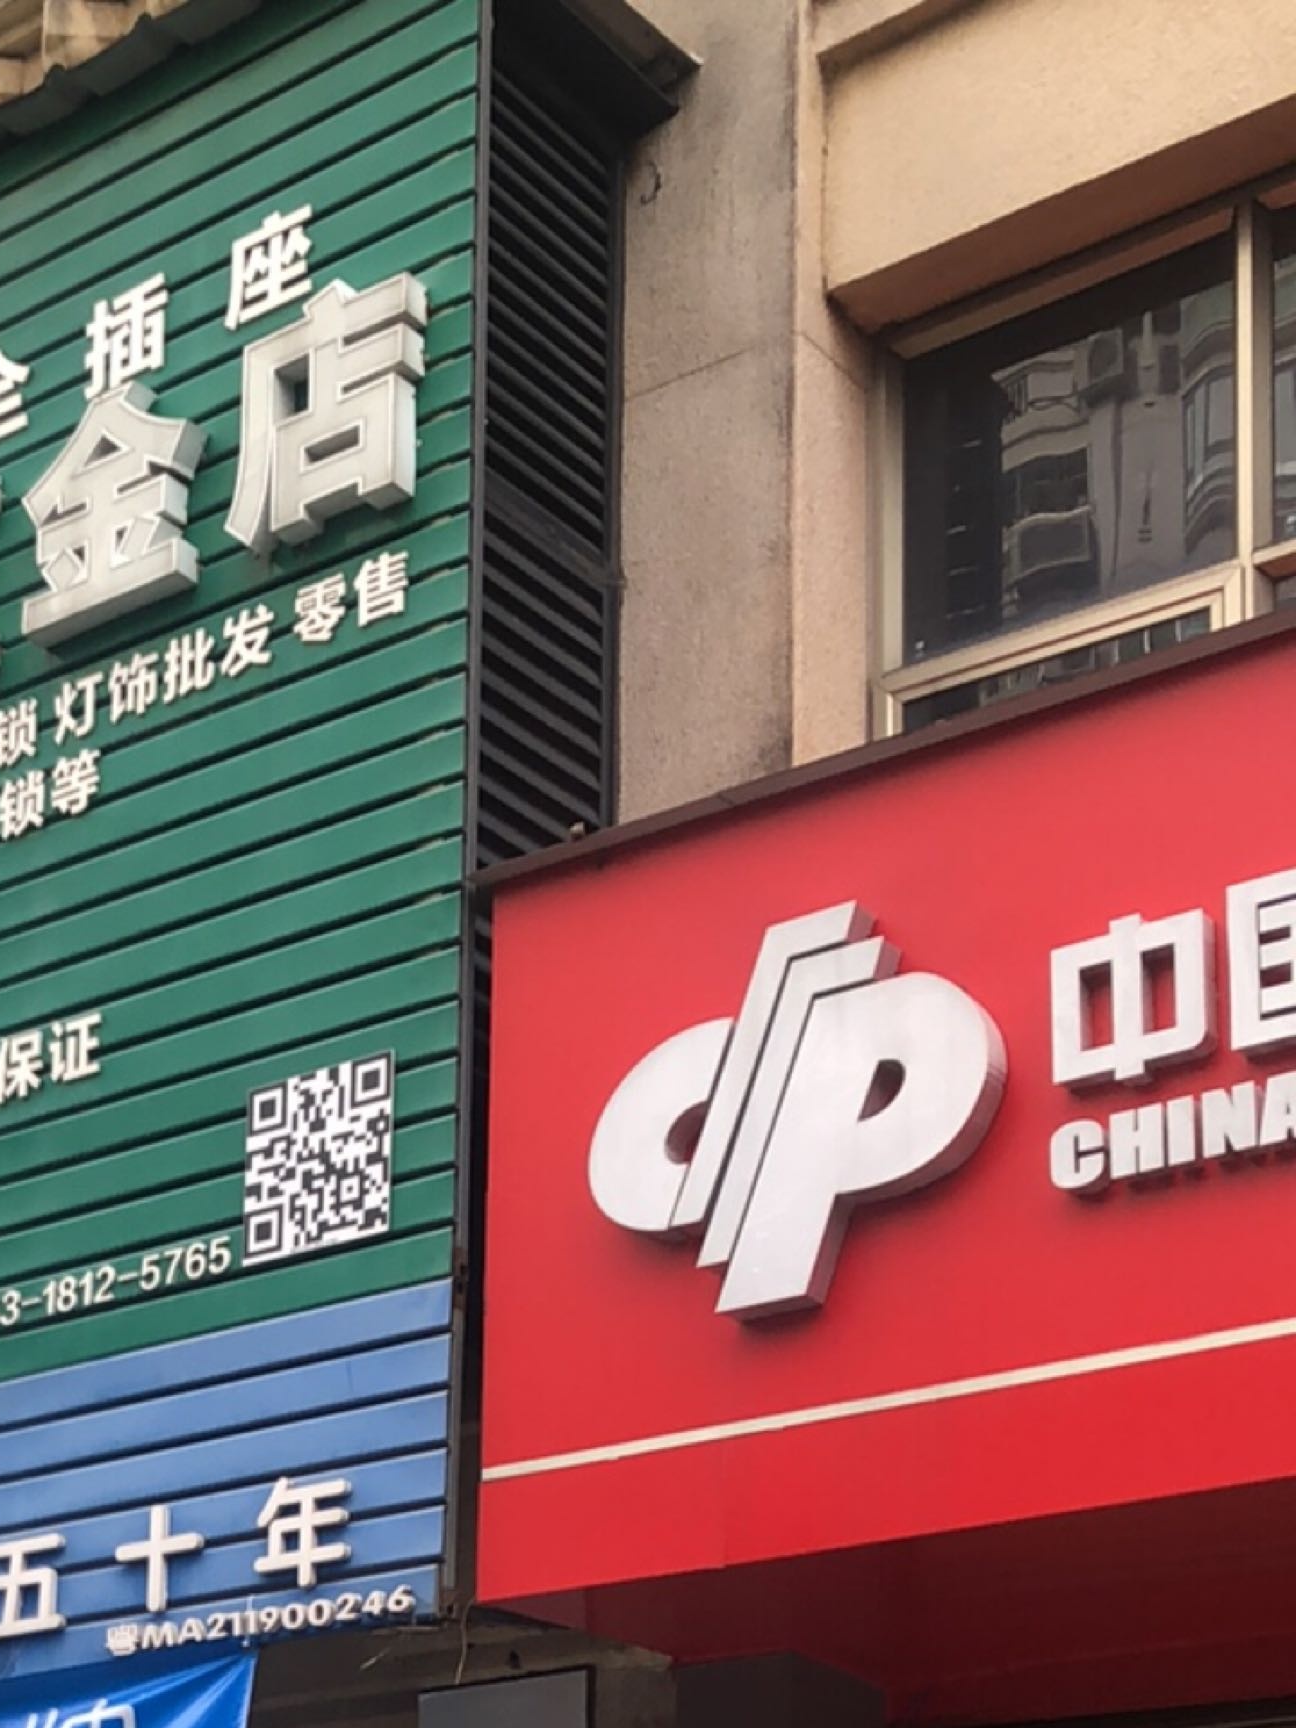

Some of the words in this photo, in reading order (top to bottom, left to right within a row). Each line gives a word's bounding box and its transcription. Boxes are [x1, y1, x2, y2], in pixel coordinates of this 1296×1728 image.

[53, 604, 275, 746] 灯饰批发
[293, 551, 410, 643] 零售
[1050, 1069, 1296, 1190] CHINA
